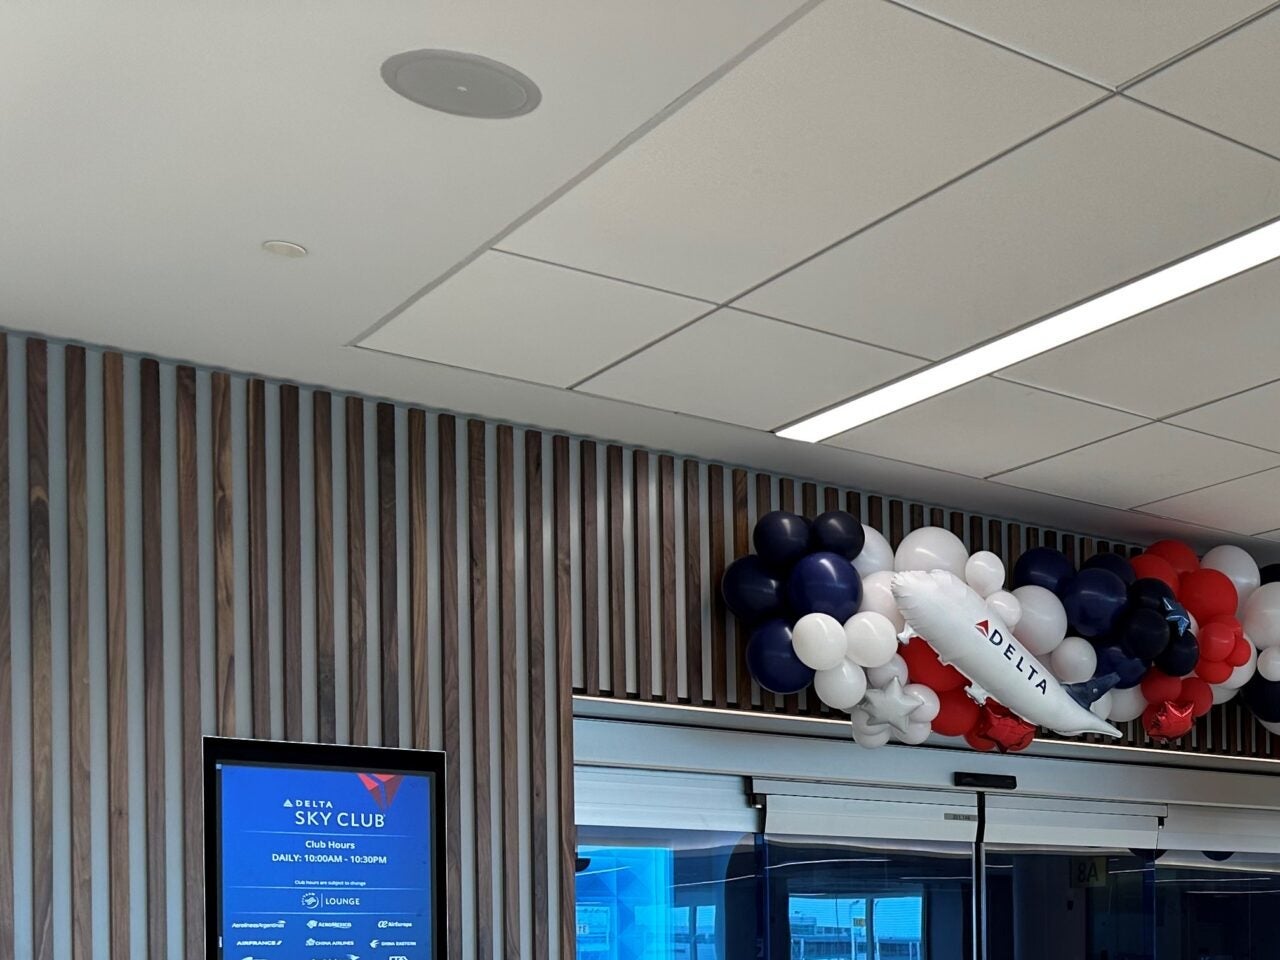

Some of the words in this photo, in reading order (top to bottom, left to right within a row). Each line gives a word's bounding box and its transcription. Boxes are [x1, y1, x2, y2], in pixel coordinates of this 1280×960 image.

[989, 628, 1047, 694] DELTA
[296, 800, 333, 808] DELTA
[295, 810, 332, 826] SKY
[337, 812, 386, 828] CLUB
[305, 840, 326, 848] Club
[328, 841, 355, 849] Hours
[272, 854, 302, 862] DAILY:
[304, 854, 343, 863] 10:00AM
[350, 855, 387, 864] 10:30PM
